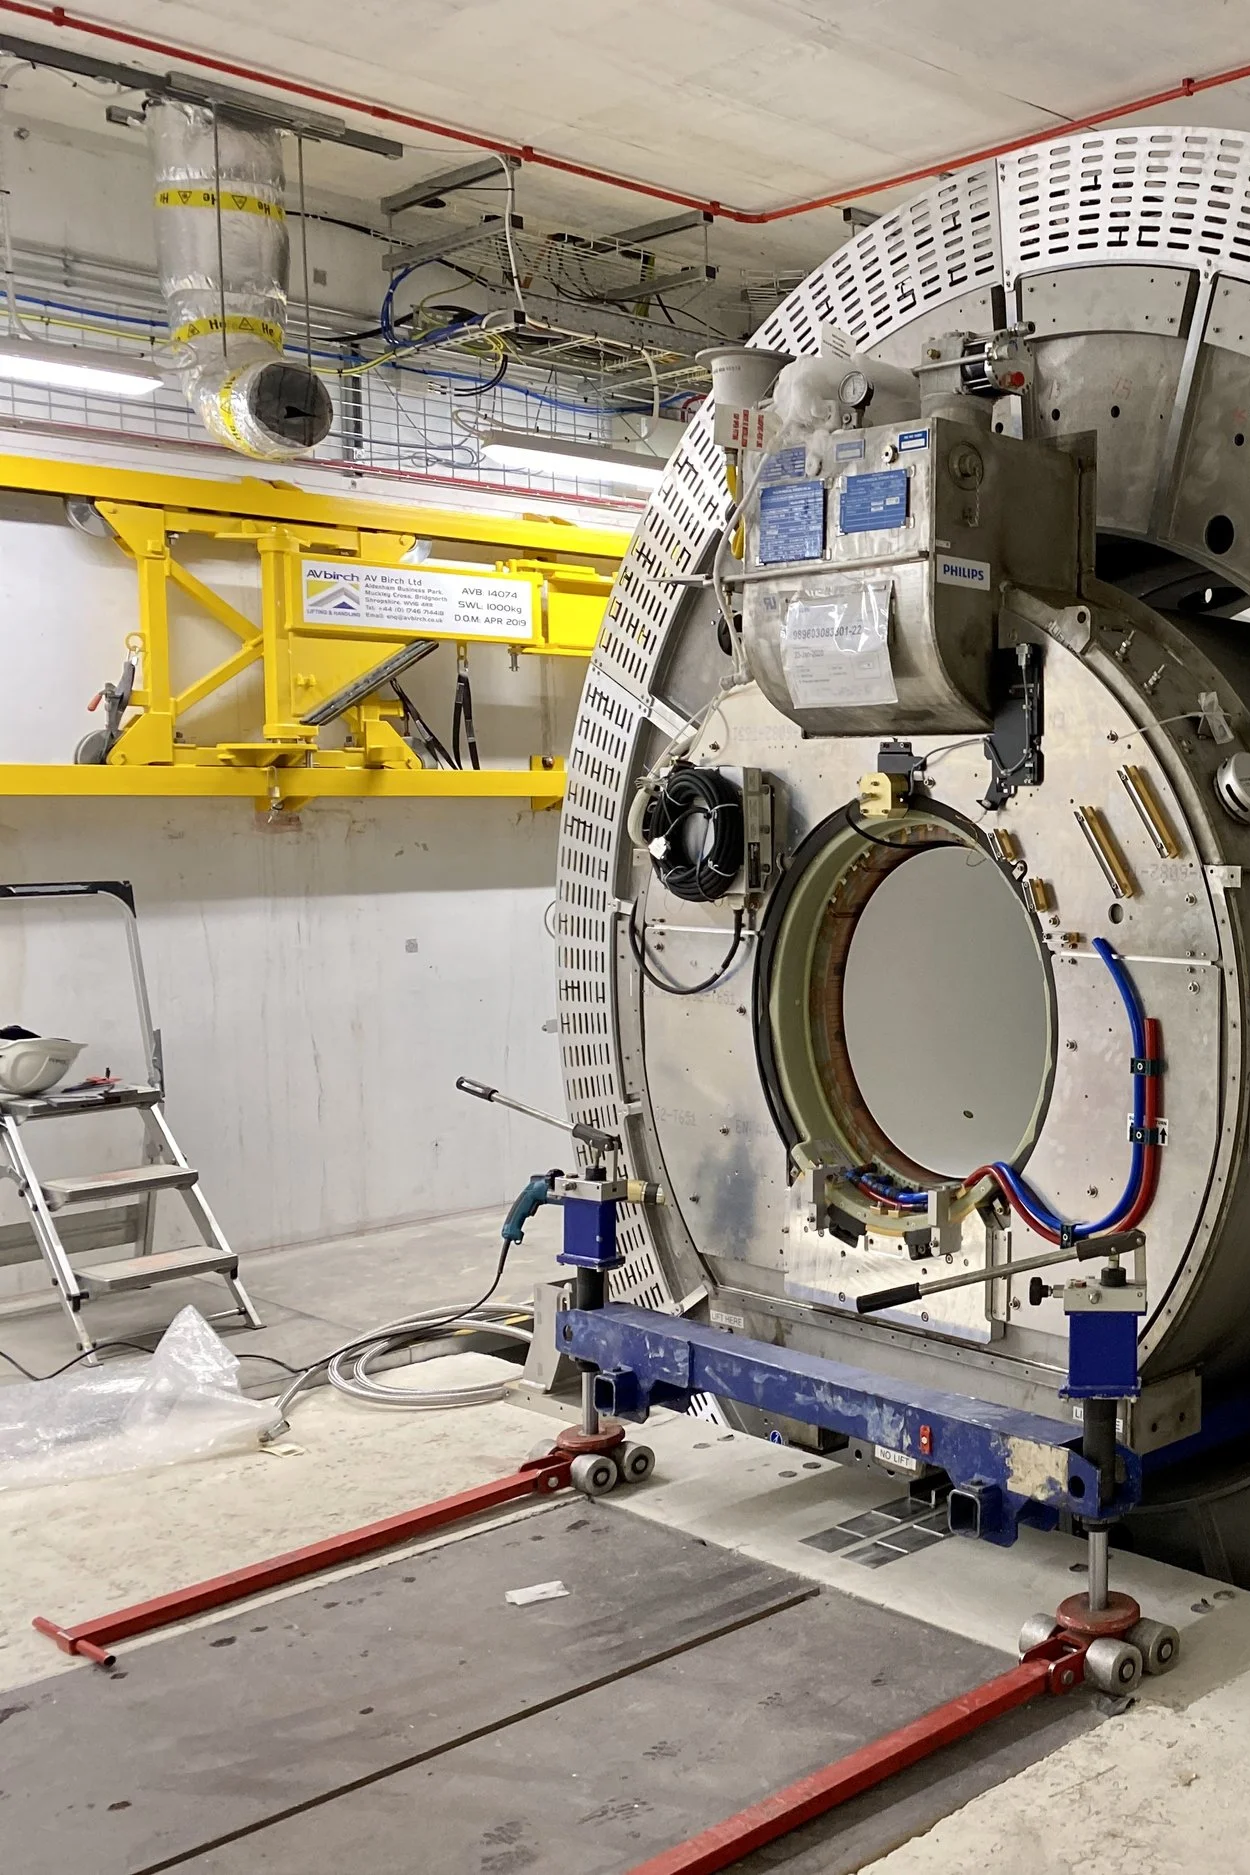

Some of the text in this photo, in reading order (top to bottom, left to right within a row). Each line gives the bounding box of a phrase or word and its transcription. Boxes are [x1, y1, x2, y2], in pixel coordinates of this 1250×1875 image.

[306, 569, 360, 582] AVbirch
[943, 563, 984, 581] PHILIPS
[364, 574, 422, 586] AV Birch Ltd
[365, 590, 391, 598] Muckley
[414, 594, 448, 602] Bridgnorth
[488, 590, 518, 599] 14074
[333, 610, 361, 618] HANDLING
[486, 603, 522, 615] 1000kg
[484, 616, 503, 624] APR
[506, 618, 527, 627] 2019
[711, 1312, 743, 1327] LIFT HERE
[879, 1448, 910, 1467] NO LIFT
